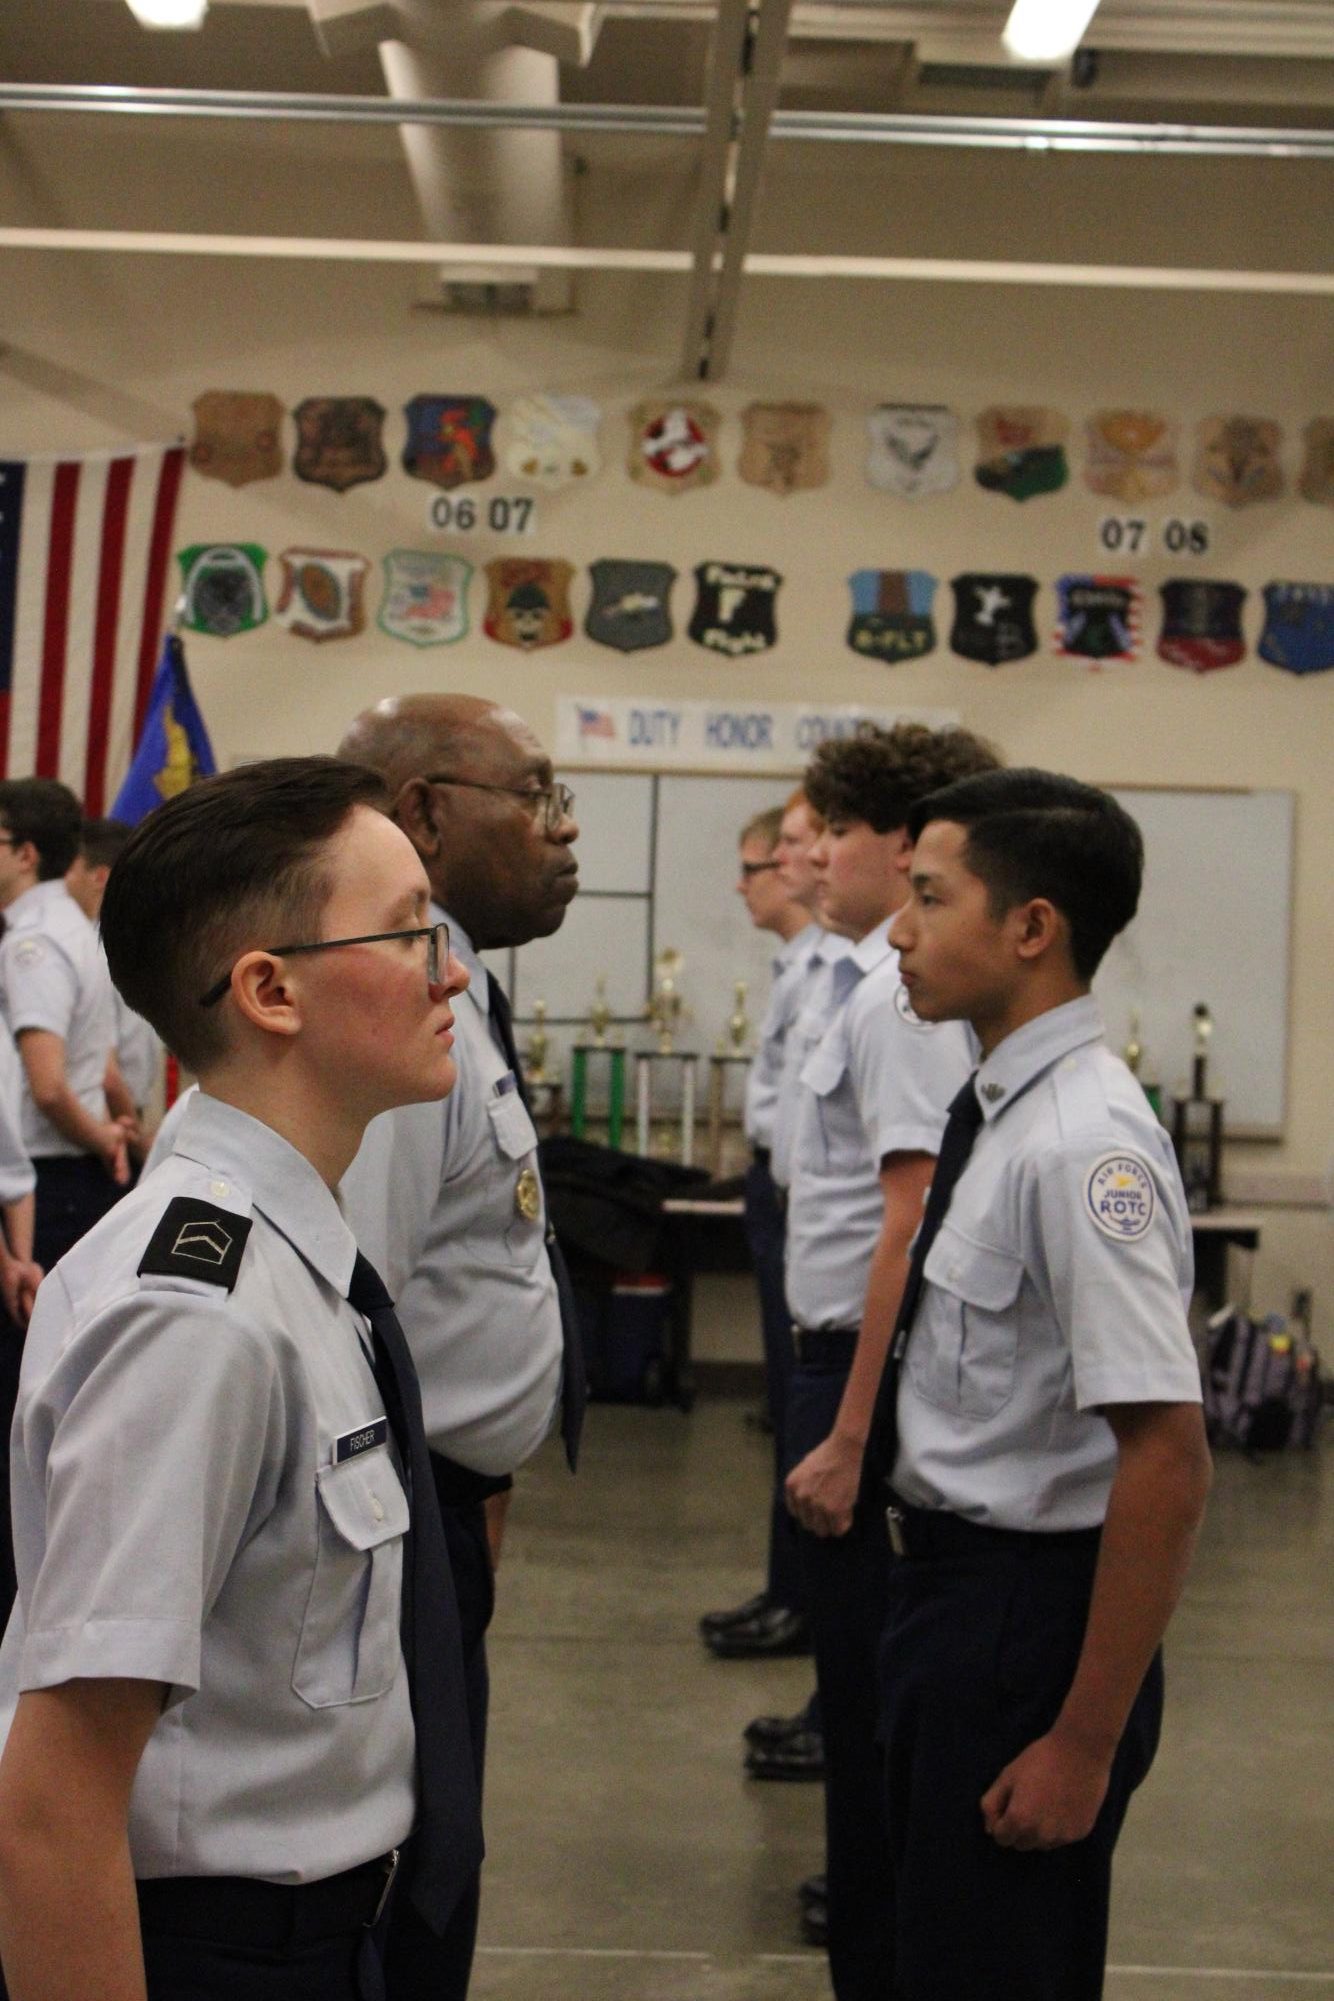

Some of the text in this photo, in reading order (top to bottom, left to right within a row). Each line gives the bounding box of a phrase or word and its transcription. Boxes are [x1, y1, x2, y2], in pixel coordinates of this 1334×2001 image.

[431, 496, 534, 533] 06 07
[1101, 518, 1210, 557] 07 08
[629, 709, 681, 747] DUTY
[706, 713, 774, 750] HONOR
[1099, 1200, 1147, 1216] ROTC
[1104, 1189, 1143, 1201] JUNIOR
[349, 1429, 375, 1452] FISCHER
